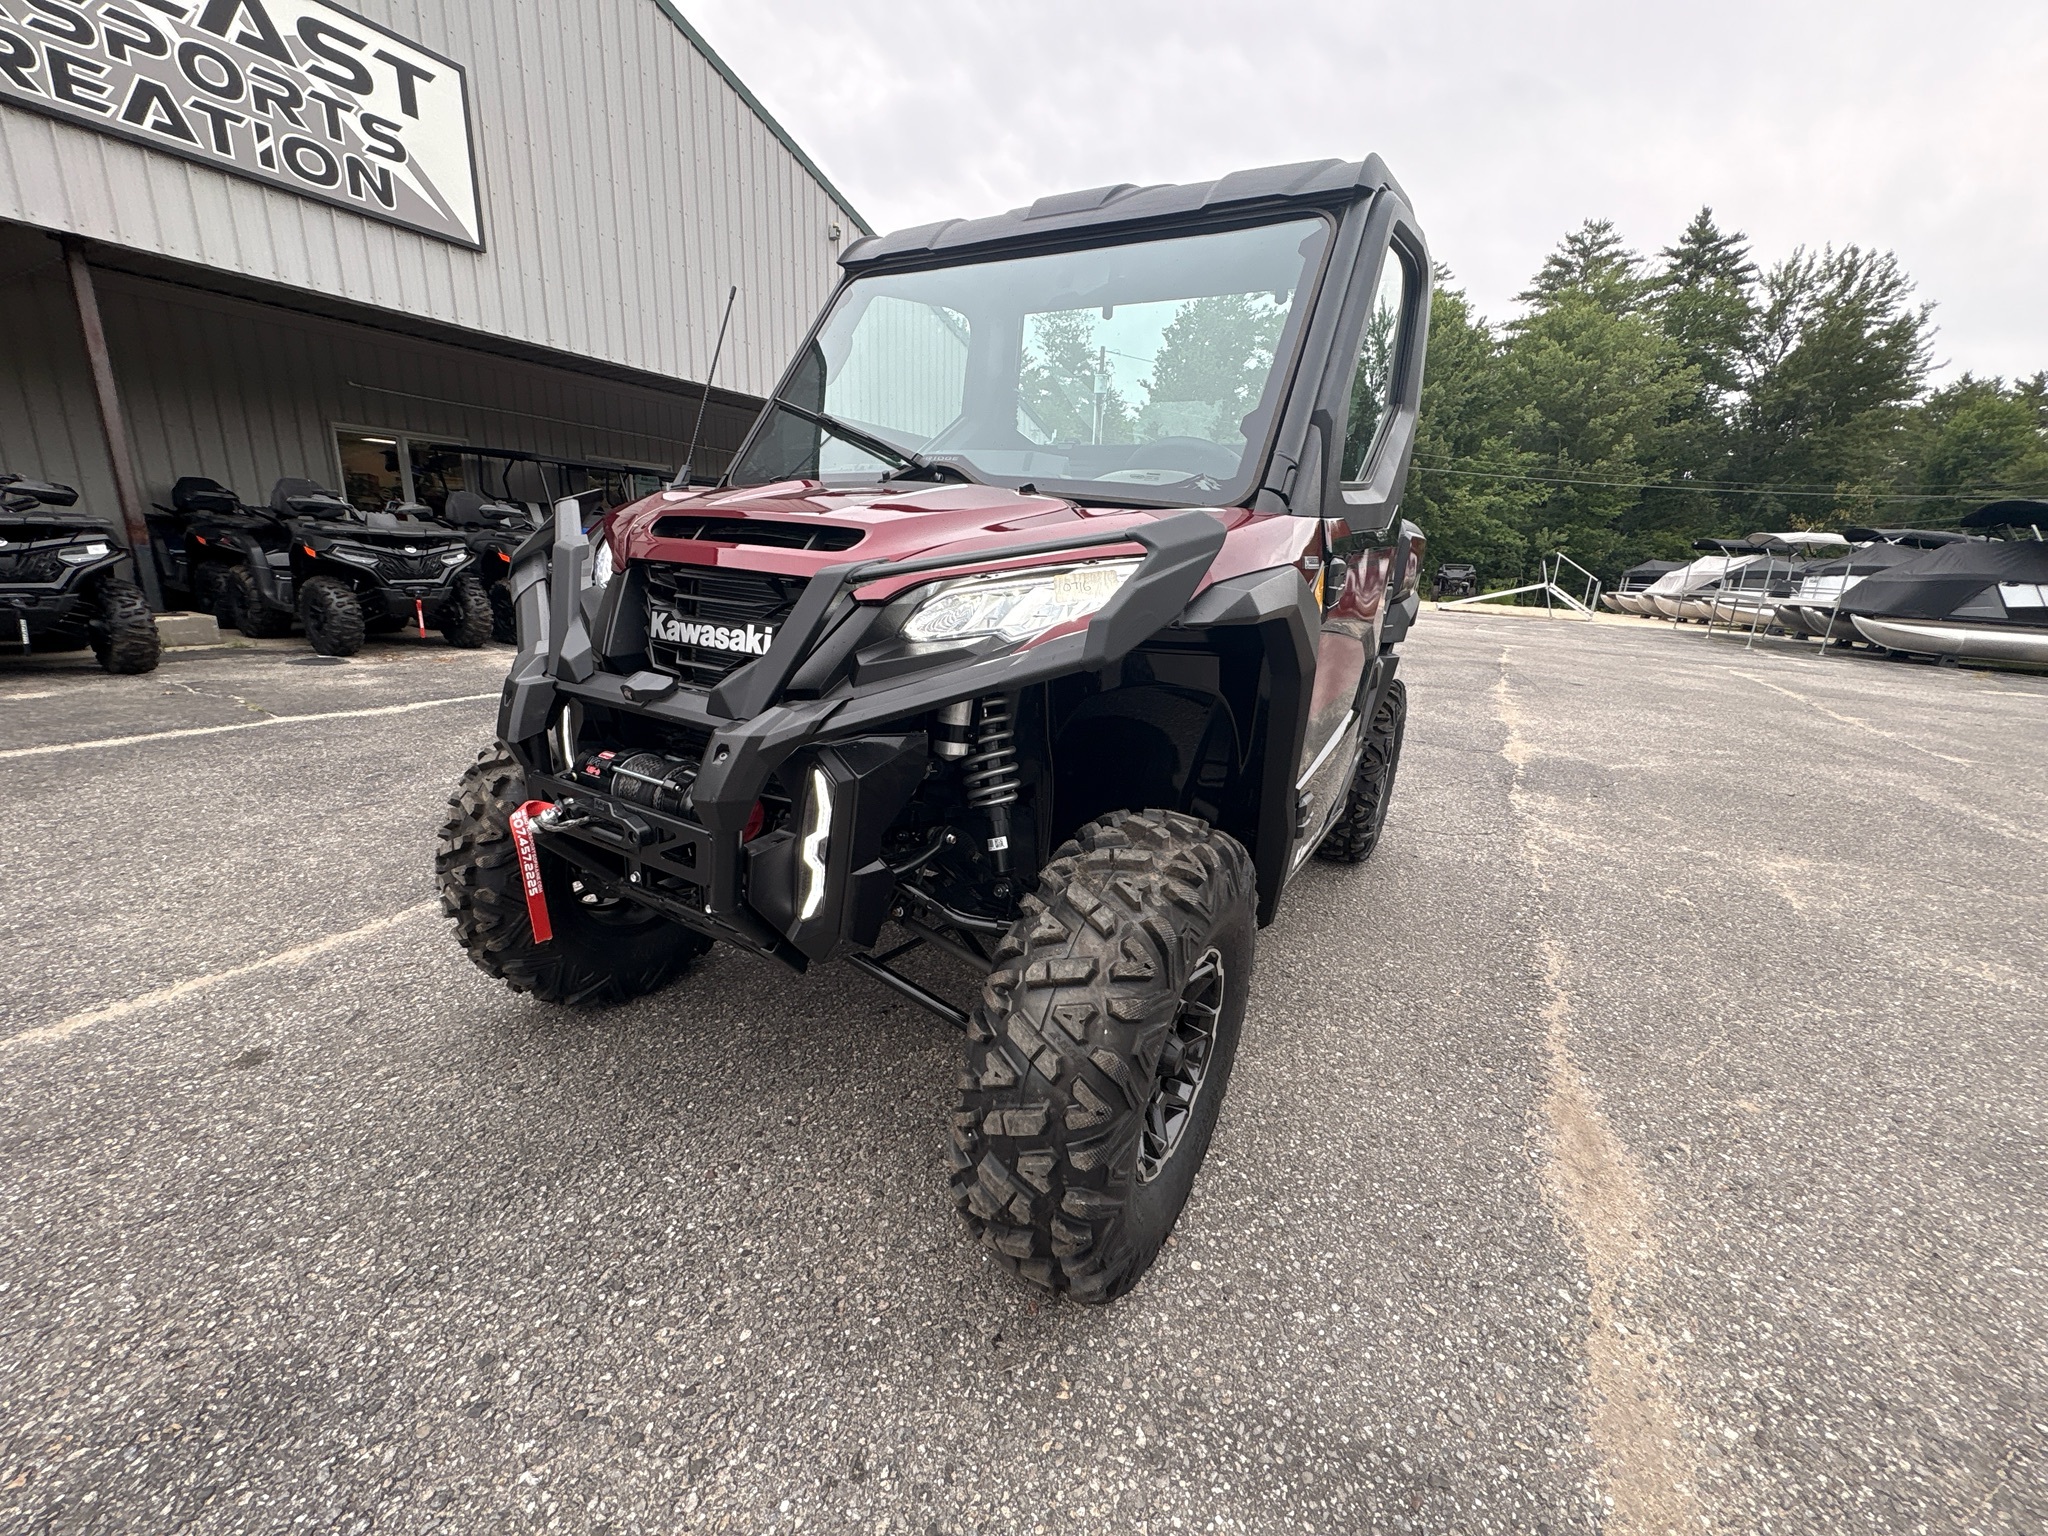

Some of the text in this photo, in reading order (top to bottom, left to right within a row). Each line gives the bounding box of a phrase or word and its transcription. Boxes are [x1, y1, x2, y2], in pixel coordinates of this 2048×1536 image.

[0, 0, 408, 164] SPORTS
[141, 0, 437, 121] AST
[650, 610, 773, 656] Kawasaki
[511, 811, 539, 897] 207.457.2225
